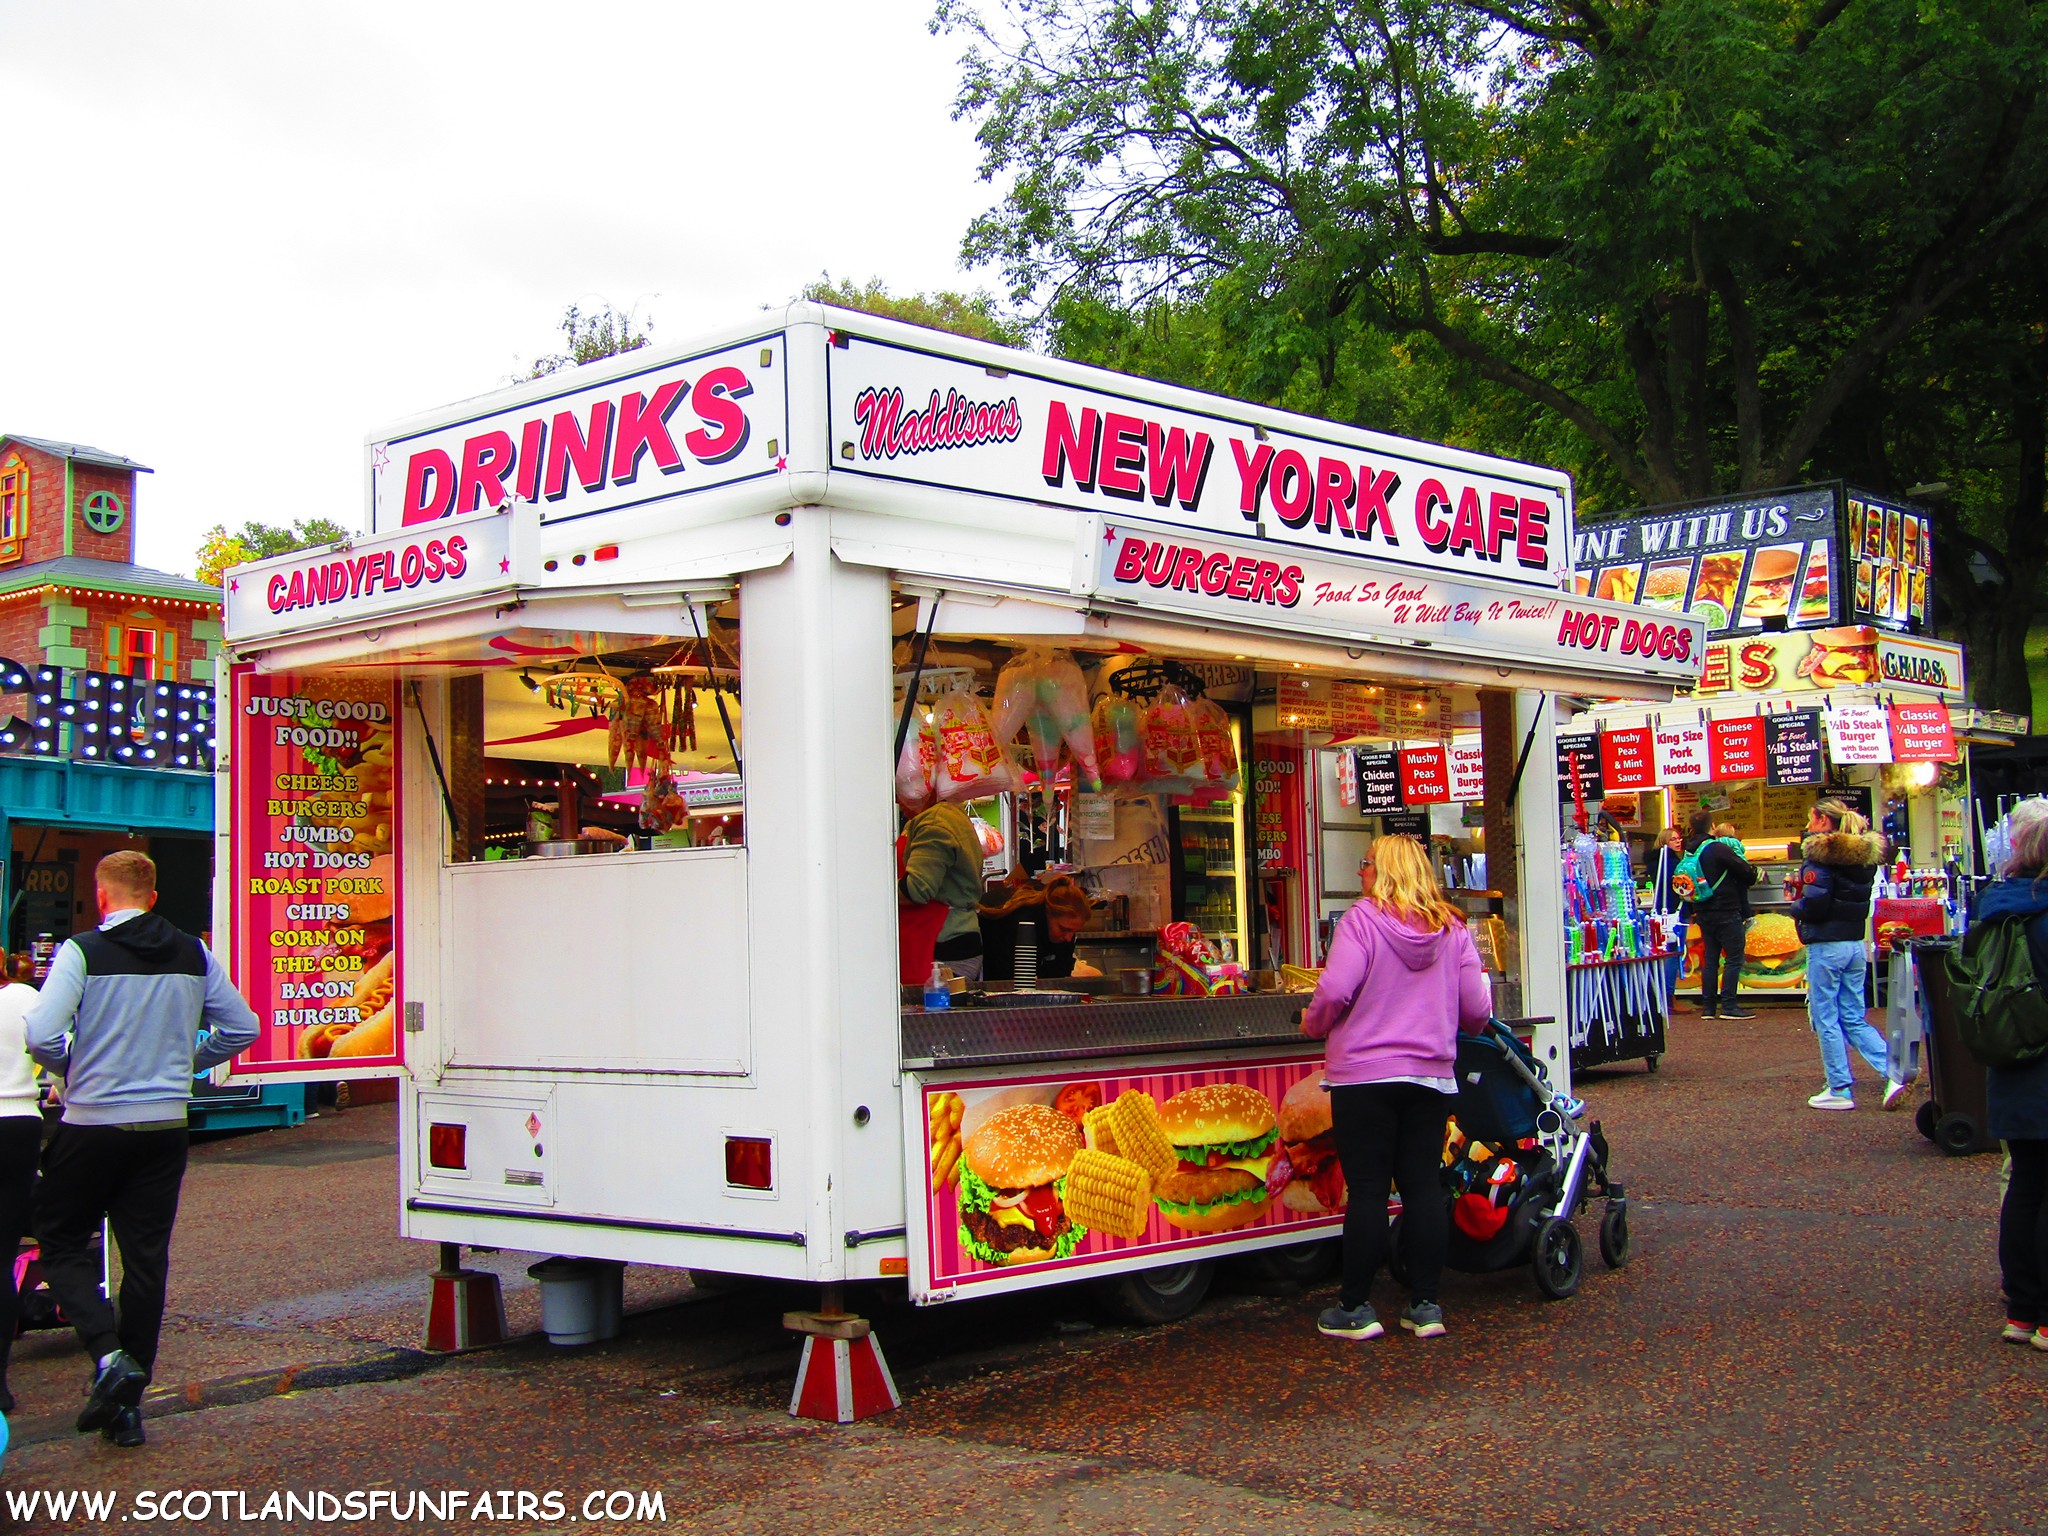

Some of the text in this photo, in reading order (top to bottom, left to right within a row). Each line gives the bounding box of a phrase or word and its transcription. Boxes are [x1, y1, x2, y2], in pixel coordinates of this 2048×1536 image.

[855, 386, 1022, 460] Maddisons
[401, 366, 753, 527] DRINKS
[1042, 400, 1550, 570] NEW YORK CAFE
[1640, 515, 1734, 553] WITH
[1741, 505, 1789, 541] US
[267, 535, 469, 614] CANDYFLOSS
[1114, 537, 1304, 608] BURGERS
[1312, 582, 1427, 606] Food So Good
[1394, 600, 1556, 627] U Will Buy It Twice!!
[1557, 609, 1693, 663] HOT DOGS
[1888, 653, 1943, 686] CHIPS
[245, 696, 387, 721] JUST GOOD
[1851, 708, 1869, 717] Beast
[1900, 710, 1938, 721] Classic
[1717, 722, 1752, 733] Chinese
[1778, 721, 1805, 729] SPECIAL
[1852, 719, 1883, 731] Steak
[1921, 722, 1946, 734] Beef
[275, 726, 358, 748] FOOD!!
[1612, 733, 1641, 744] Mushy
[1656, 730, 1704, 746] King Size
[1723, 736, 1748, 747] Curry
[1777, 731, 1807, 741] The Beast
[1840, 731, 1876, 743] Burger
[1790, 740, 1819, 752] Steak
[1841, 744, 1880, 752] with Bacon
[1904, 738, 1943, 749] Burger
[1617, 747, 1638, 756] Peas
[1669, 746, 1693, 759] Pork
[1723, 750, 1750, 760] Sauce
[1846, 752, 1877, 760] & Cheese
[1407, 754, 1438, 765] Mushy
[1615, 758, 1643, 769] & Mint
[1776, 754, 1811, 767] Burger
[1259, 760, 1295, 774] GOOD
[1663, 763, 1701, 776] Hotdog
[1720, 762, 1755, 774] & Chips
[1777, 766, 1812, 776] with Bacon
[1362, 770, 1395, 781] Chicken
[1413, 769, 1435, 779] Peas
[1617, 773, 1642, 783] Sauce
[1787, 774, 1809, 783] Cheese
[276, 773, 359, 792] CHEESE
[1366, 782, 1393, 793] Zinger
[690, 789, 711, 802] FOR
[1408, 786, 1415, 795] &
[1418, 784, 1444, 796] Chips
[1367, 794, 1395, 806] Burger
[267, 799, 368, 818] BURGERS
[279, 826, 354, 843] JUMBO
[263, 852, 371, 869] HOT DOGS
[250, 877, 384, 895] ROAST PORK
[286, 904, 350, 920] CHIPS
[270, 929, 366, 947] CORN ON
[272, 955, 364, 973] THE COB
[280, 981, 355, 1000] BACON
[273, 1007, 362, 1027] BURGER
